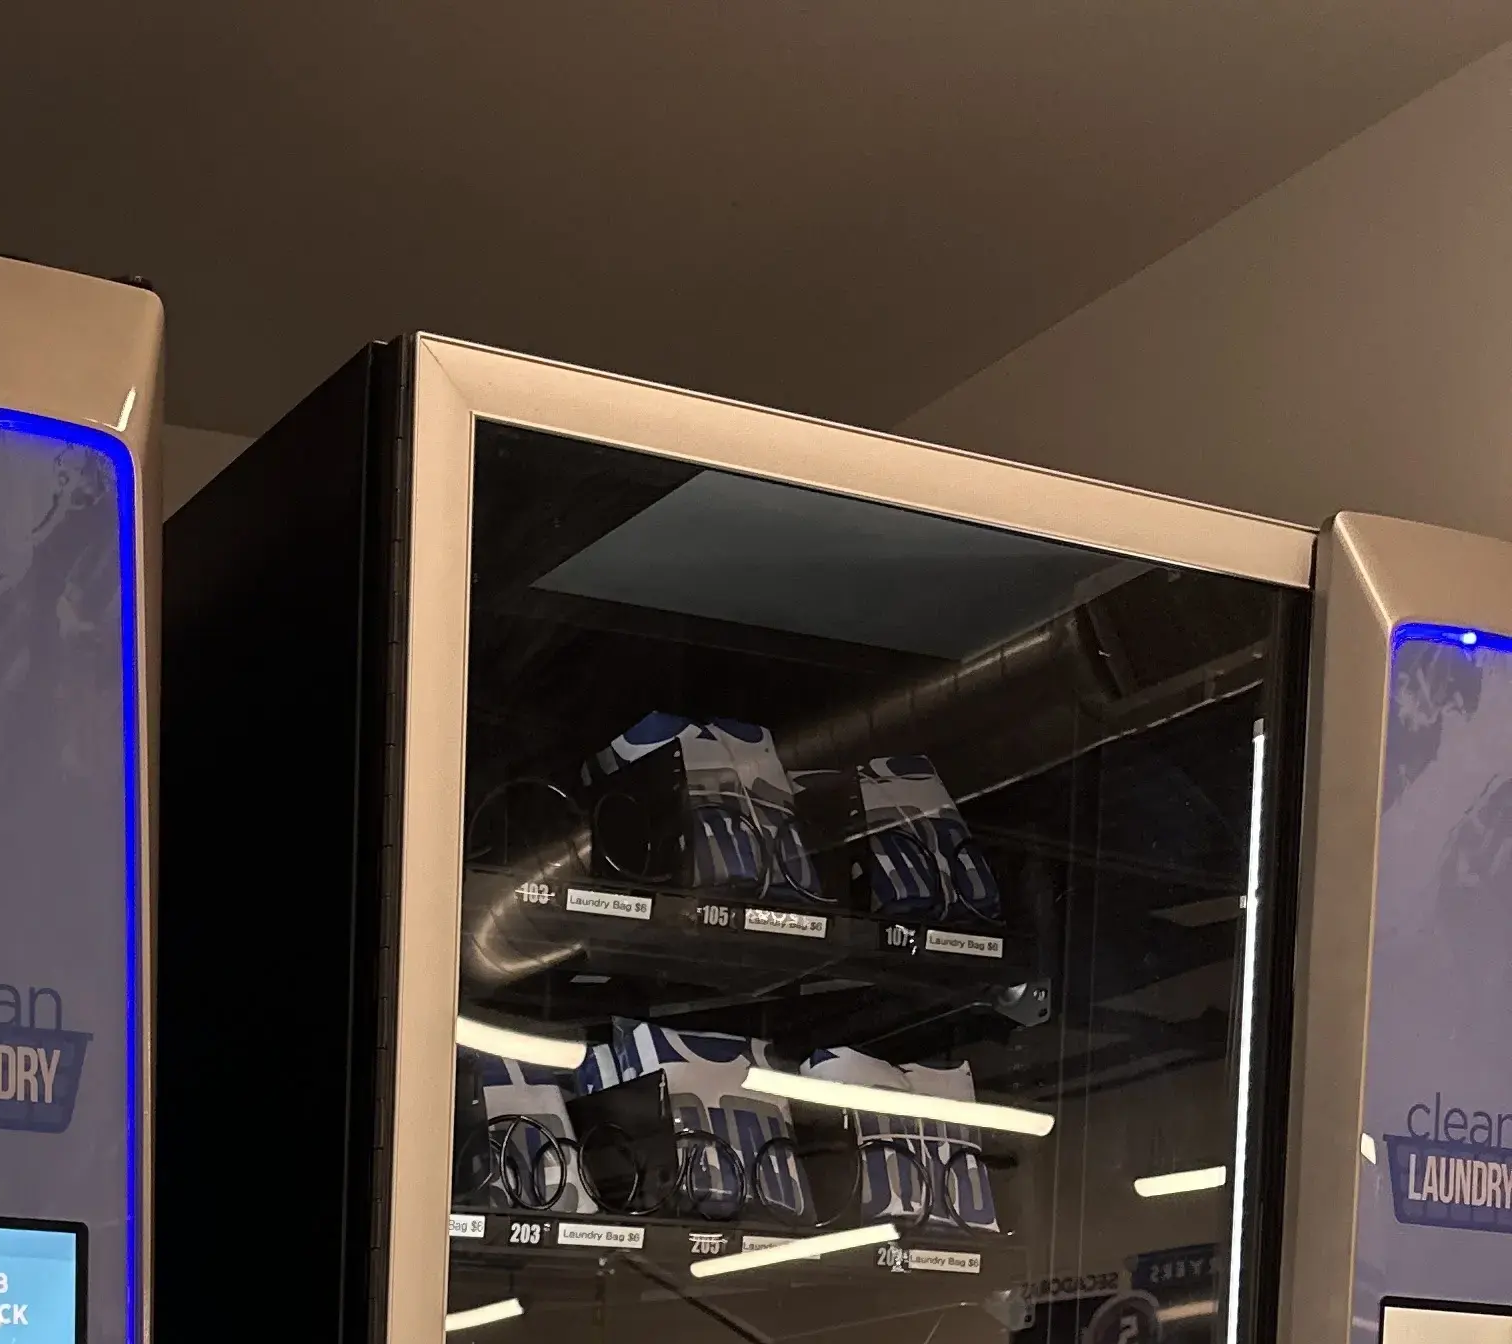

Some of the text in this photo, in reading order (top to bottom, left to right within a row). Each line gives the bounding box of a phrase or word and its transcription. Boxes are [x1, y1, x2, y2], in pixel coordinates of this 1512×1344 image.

[570, 895, 609, 909] Laundry
[613, 900, 631, 912] Bag
[703, 905, 728, 926] 105
[471, 1220, 484, 1233] $6
[509, 1223, 541, 1243] 203
[563, 1229, 603, 1241] Laundry
[605, 1231, 625, 1242] Bag
